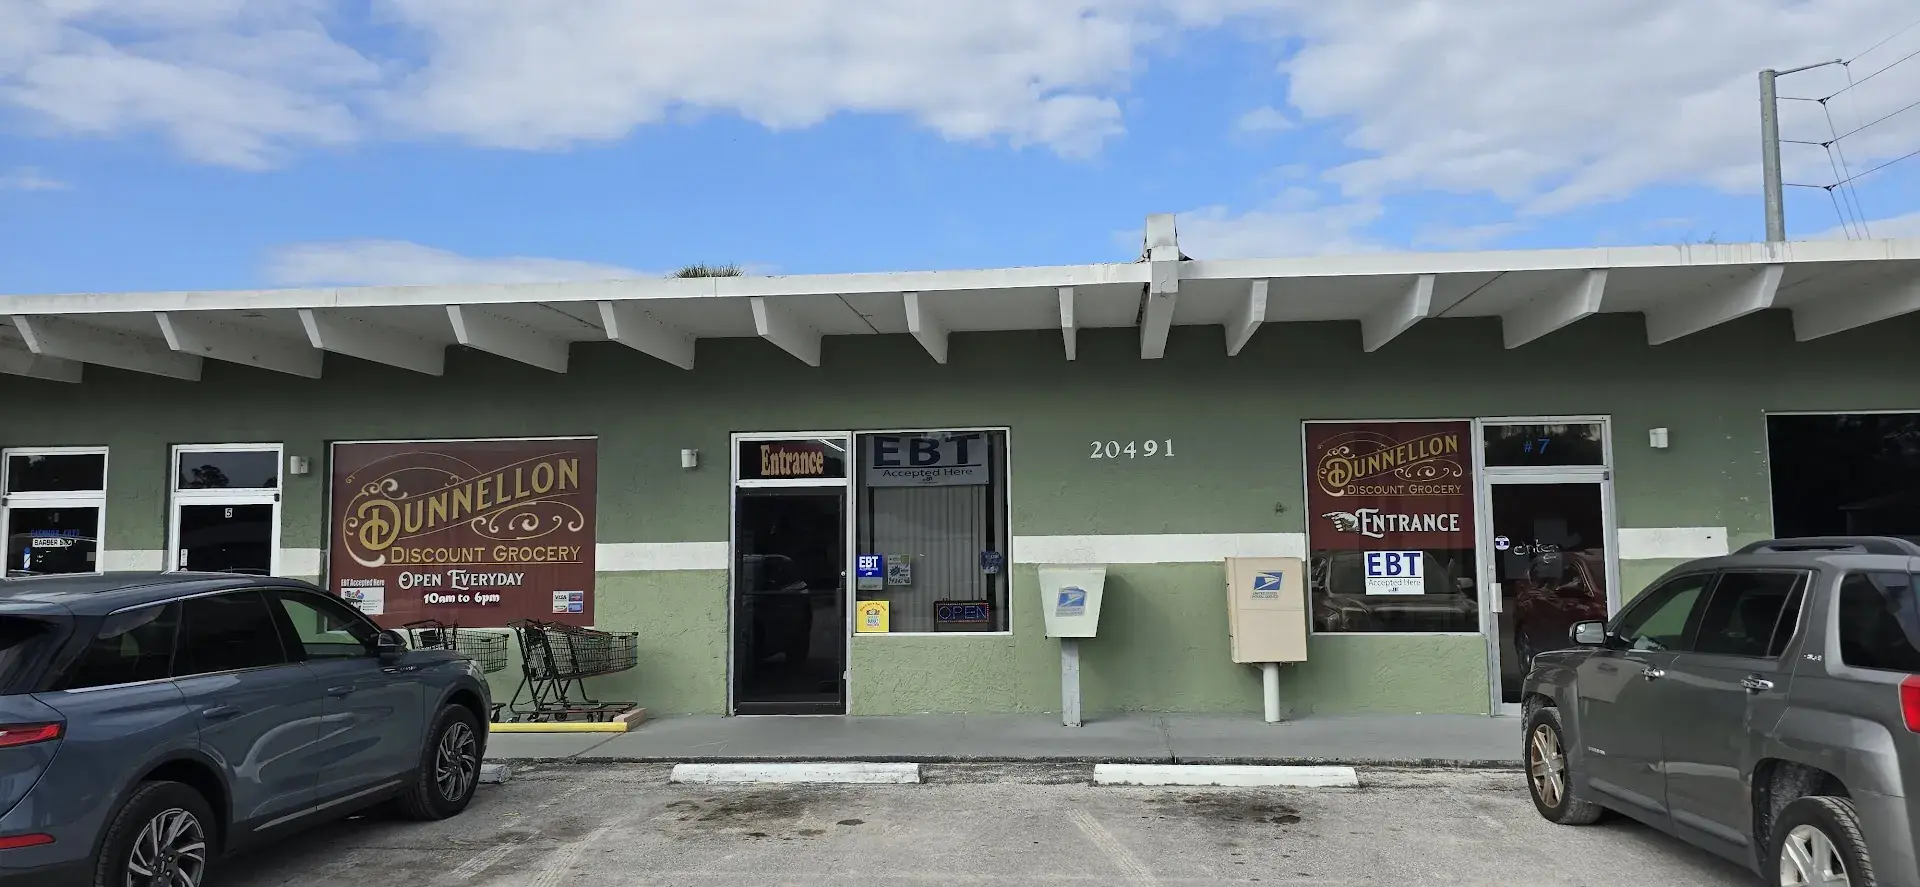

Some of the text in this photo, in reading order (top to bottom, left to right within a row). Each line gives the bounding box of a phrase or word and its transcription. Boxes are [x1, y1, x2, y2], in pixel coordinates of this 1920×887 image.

[873, 433, 981, 466] EBT
[1090, 438, 1175, 459] 20491
[1537, 438, 1550, 454] 7
[760, 444, 824, 476] Entrance
[1326, 435, 1459, 487] DUNNELLON
[882, 468, 973, 478] Accepted Here
[1347, 484, 1462, 495] DISCOUNT GROCERY
[358, 458, 579, 551] DUNNELLON
[1355, 508, 1460, 538] ENTRANCE
[391, 545, 581, 563] DISCOUNT GROCERY
[859, 556, 879, 569] EBT
[1367, 552, 1421, 576] EBT
[398, 569, 525, 590] OPEN EVERYDAY
[1368, 578, 1421, 588] Accepted Here
[423, 591, 500, 606] 10am to 6pm
[938, 605, 987, 620] OPEN
